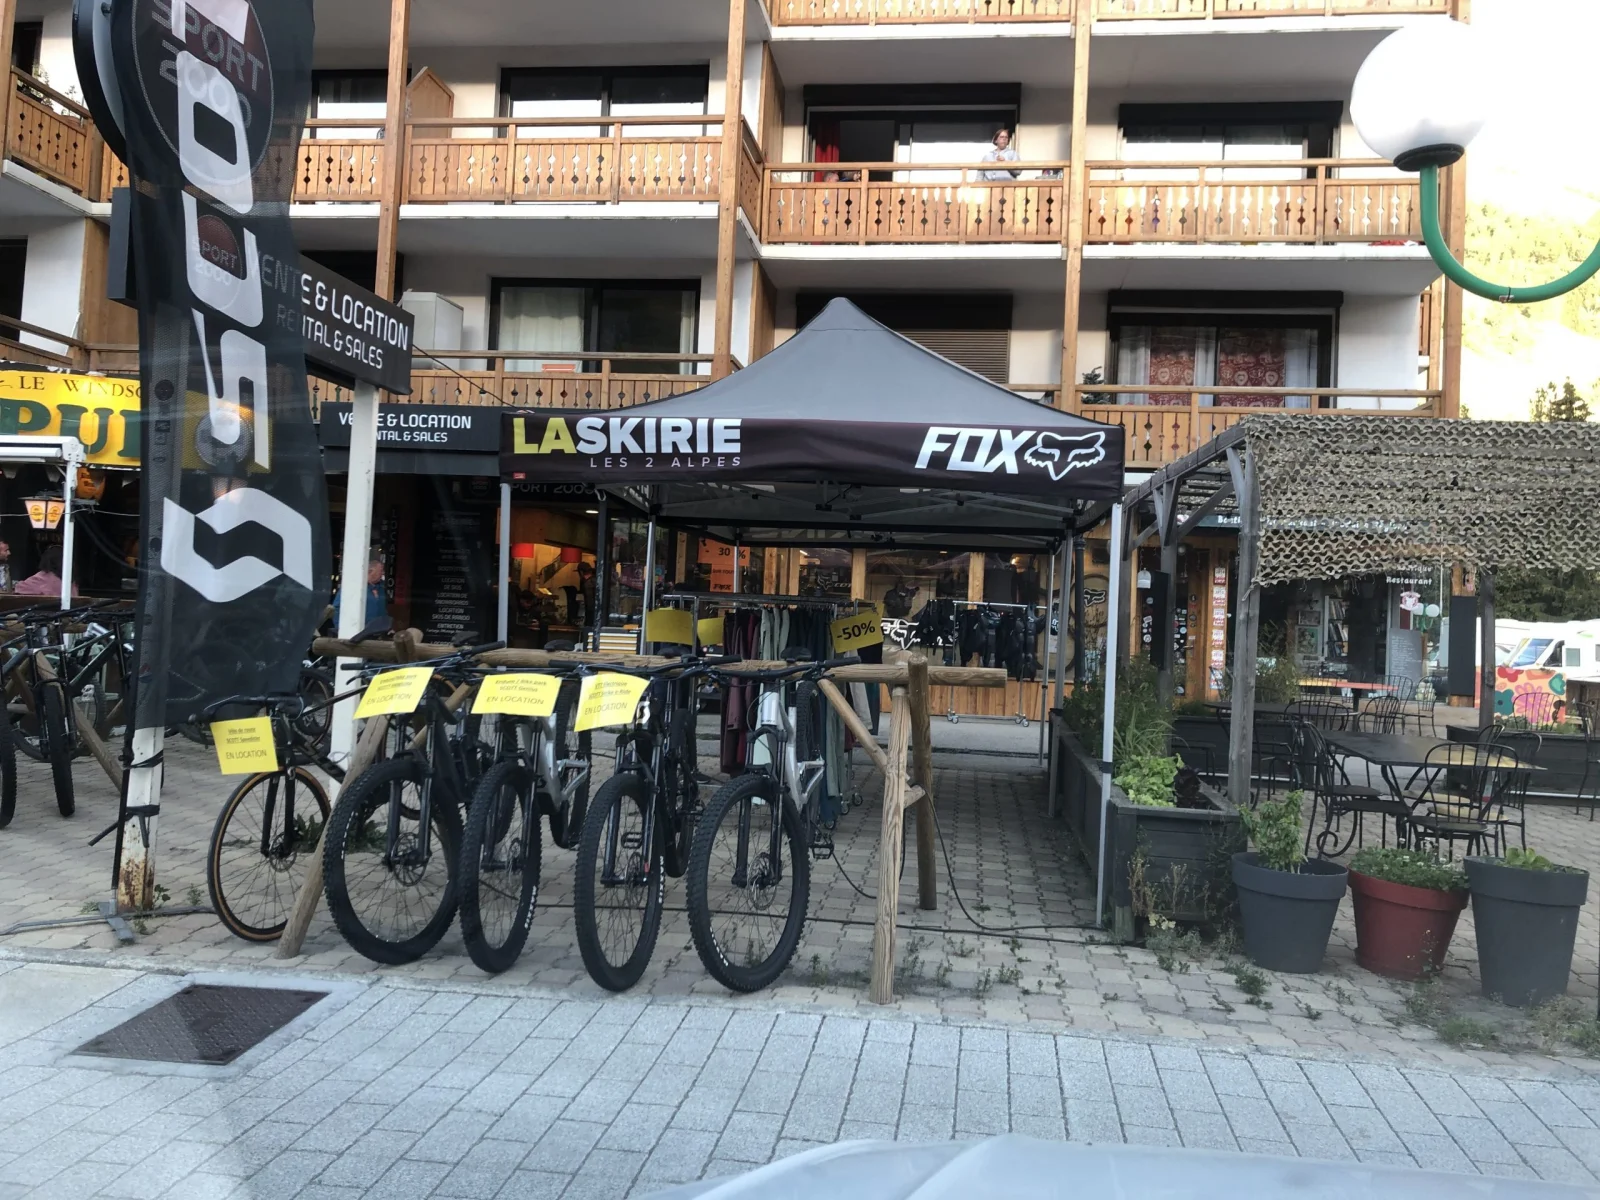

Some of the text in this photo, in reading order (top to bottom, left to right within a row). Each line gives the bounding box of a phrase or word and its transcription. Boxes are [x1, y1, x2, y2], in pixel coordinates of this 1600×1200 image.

[315, 281, 328, 311] &
[331, 288, 408, 350] LOCATION
[333, 330, 343, 351] &
[345, 335, 383, 369] SALES
[20, 375, 45, 391] LE
[387, 413, 398, 427] &
[400, 414, 472, 429] LOCATION
[403, 431, 411, 442] &
[413, 431, 448, 443] SALES
[914, 426, 1037, 474] FOX
[590, 456, 741, 468] LES 2 ALPES
[718, 547, 731, 556] 30
[1386, 577, 1432, 585] Restaurant
[836, 620, 876, 640] -50%
[501, 695, 545, 705] LOCATION
[585, 702, 628, 715] EN LOCATION
[226, 749, 267, 759] EN LOCATION
